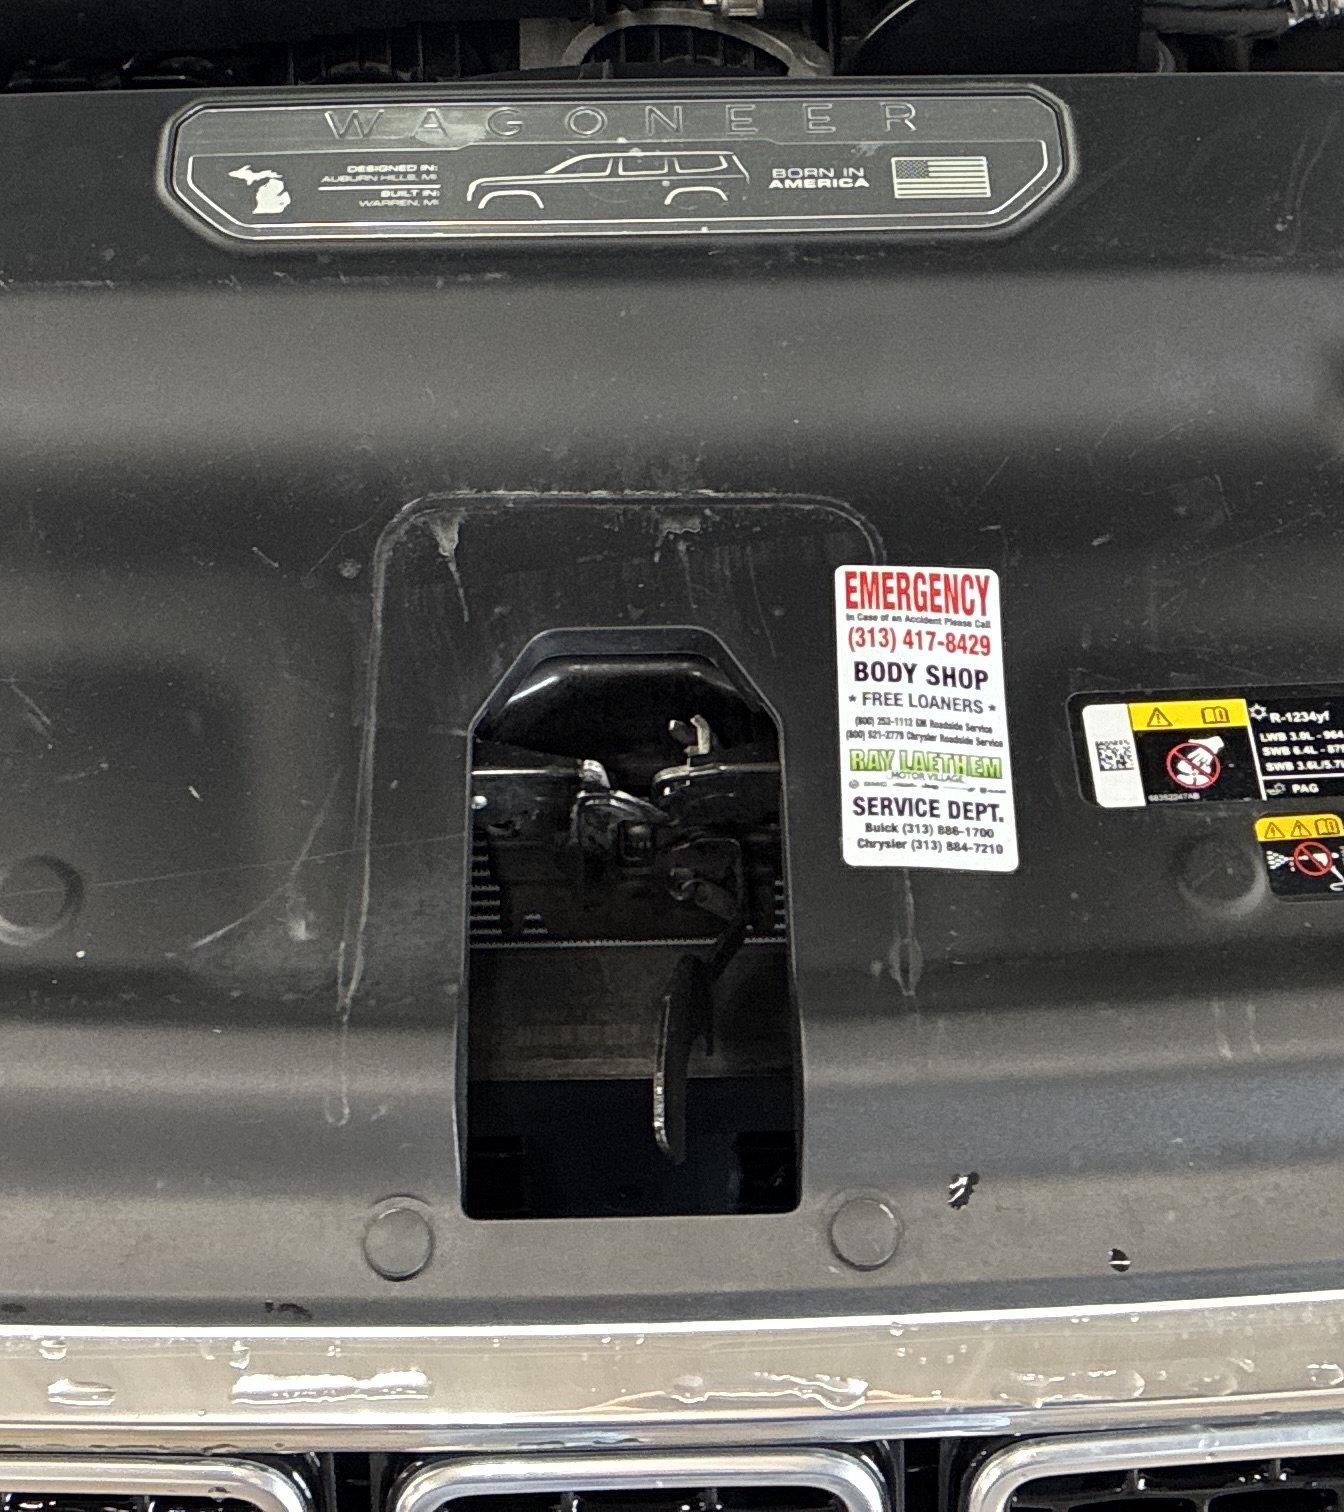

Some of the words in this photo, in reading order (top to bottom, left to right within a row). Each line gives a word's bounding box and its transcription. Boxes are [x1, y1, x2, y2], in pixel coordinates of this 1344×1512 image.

[323, 101, 920, 141] WAGONEER
[346, 164, 418, 174] DESIGNED
[771, 167, 835, 179] BORN
[842, 167, 865, 177] IN
[320, 174, 379, 183] AUBURN
[420, 173, 438, 181] MI
[767, 177, 871, 189] AMERICA
[380, 189, 420, 198] BUILT
[422, 198, 439, 206] MI
[844, 570, 991, 617] EMERGENCY
[856, 613, 879, 623] Case
[880, 613, 891, 623] of
[891, 614, 902, 623] an
[904, 614, 944, 626] Accident
[944, 616, 974, 629] Please
[974, 619, 992, 629] Call
[847, 627, 898, 653] (313)
[902, 629, 992, 657] 417-8429
[853, 660, 918, 684] BODY
[925, 664, 990, 690] SHOP
[861, 691, 904, 708] FREE
[908, 694, 985, 714] LOANERS
[1269, 710, 1331, 725] R-1234yf
[929, 719, 964, 731] Roadside
[965, 722, 994, 734] Service
[906, 731, 938, 743] Chrysler
[939, 733, 974, 746] Roadside
[975, 736, 1004, 748] Service
[1260, 731, 1288, 743] LWB
[1262, 745, 1291, 757] SWB
[849, 748, 895, 772] RAY
[898, 749, 1003, 780] LAETHEM
[1265, 760, 1295, 772] SWB
[891, 771, 925, 781] MOTOR
[927, 773, 966, 784] VILLAGE
[1291, 783, 1320, 794] PAG
[852, 796, 942, 819] SERVICE
[947, 800, 1005, 823] DEPT.
[864, 821, 899, 835] Buick
[902, 823, 934, 837] (313)
[856, 837, 908, 852] Chrysler
[910, 839, 943, 854] (313)
